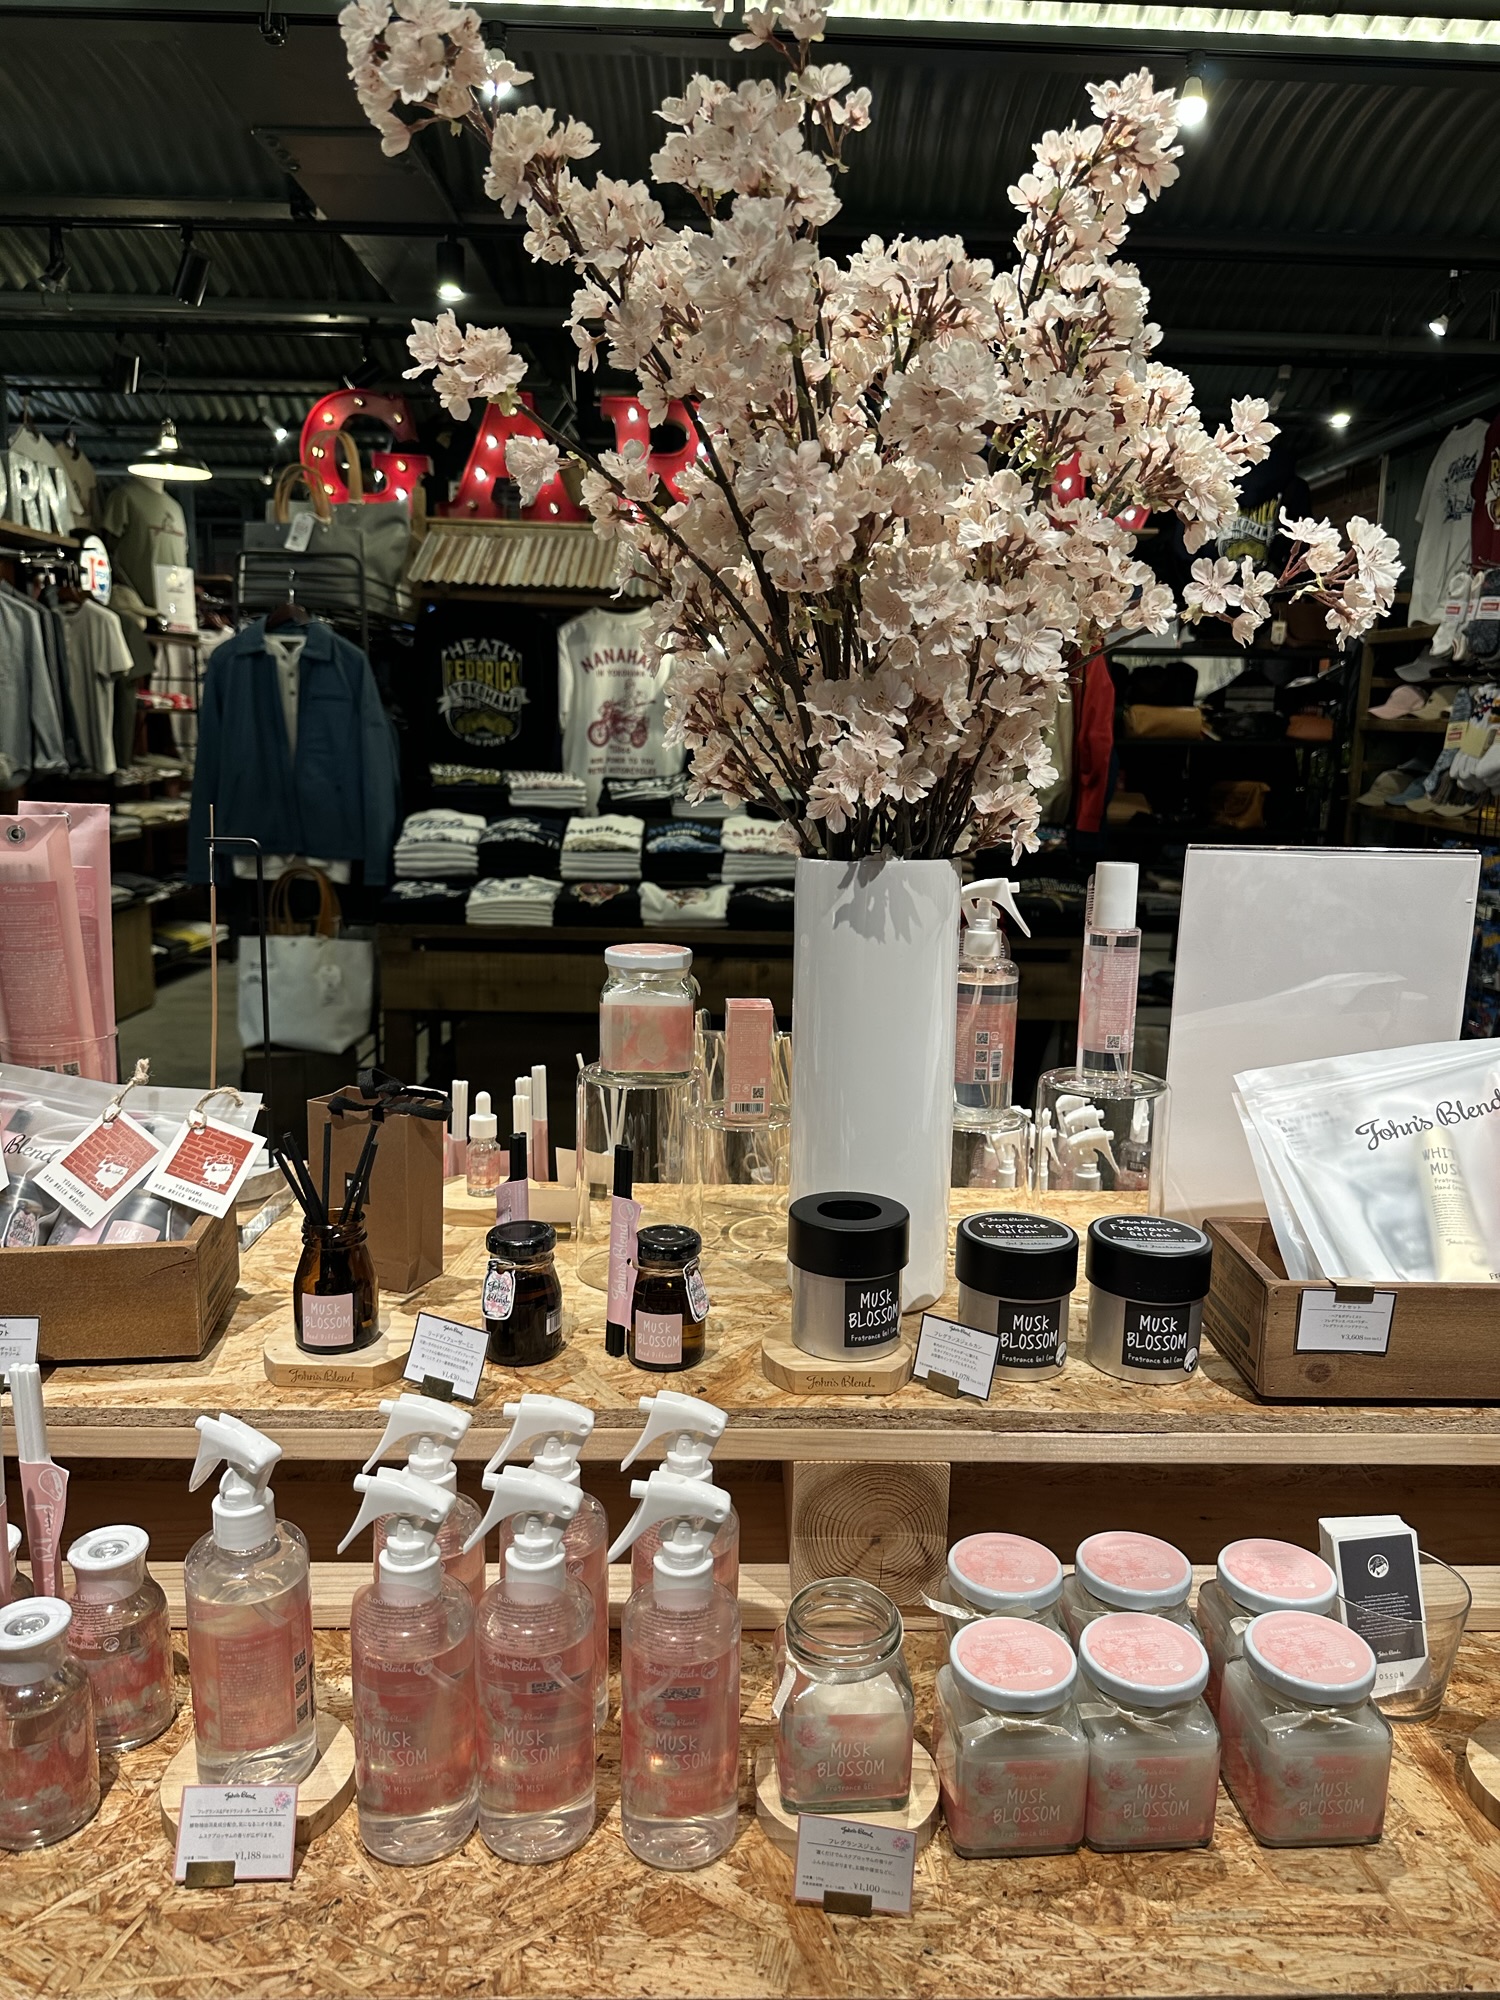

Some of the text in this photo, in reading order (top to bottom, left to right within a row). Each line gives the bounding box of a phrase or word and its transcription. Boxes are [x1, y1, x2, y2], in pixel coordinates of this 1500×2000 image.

[581, 648, 650, 674] NANAHA
[1354, 1088, 1500, 1151] John's Blend
[4, 1134, 61, 1163] Blend
[1422, 1147, 1458, 1161] WHIT
[1430, 1163, 1461, 1176] MUS
[115, 1225, 145, 1241] MUSK
[1109, 1223, 1181, 1233] Fragrance
[613, 1221, 629, 1258] Blend
[612, 1259, 628, 1301] John's
[860, 1288, 892, 1309] MUSK
[310, 1302, 341, 1315] MUSK
[848, 1300, 899, 1329] BLOSSOM
[305, 1315, 351, 1330] BLOSSOM
[643, 1319, 671, 1334] MUSK
[1013, 1314, 1050, 1332] MUSK
[1139, 1315, 1178, 1334] MUSK
[321, 1332, 348, 1341] Diffuser
[428, 1331, 474, 1349] リードディフューザーミニ
[637, 1333, 680, 1348] BLOSSOM
[850, 1332, 881, 1342] Fragrance
[882, 1328, 890, 1340] Gel
[934, 1331, 982, 1350] フレグランスジェルカン
[1000, 1330, 1058, 1350] BLOSSOM
[1126, 1331, 1187, 1351] BLOSSOM
[1001, 1353, 1055, 1364] Fragrance Gel Can
[1127, 1352, 1183, 1364] Fragrance Gel Can
[289, 1369, 355, 1383] John's Blend
[806, 1375, 873, 1390] John's Blend
[952, 1370, 970, 1382] ¥1,078
[497, 1593, 521, 1605] Room
[978, 1632, 1013, 1640] Fragrance
[1269, 1626, 1300, 1634] Fragrance
[382, 1661, 407, 1673] Blend
[511, 1660, 537, 1672] Blend
[372, 1727, 412, 1748] MUSK
[504, 1726, 545, 1746] MUSK
[656, 1732, 698, 1752] MUSK
[363, 1742, 428, 1767] BLOSSOM
[493, 1742, 560, 1766] BLOSSOM
[830, 1741, 871, 1758] MUSK
[817, 1758, 885, 1778] BLOSSOM
[241, 1790, 256, 1800] Blend
[394, 1786, 412, 1795] MIST
[526, 1784, 545, 1793] MIST
[825, 1783, 874, 1792] Fragrance GEL
[1136, 1782, 1176, 1800] MUSK
[1313, 1781, 1352, 1798] MUSK
[1006, 1787, 1047, 1804] MUSK
[993, 1805, 1061, 1824] BLOSSOM
[1123, 1800, 1189, 1819] BLOSSOM
[1299, 1798, 1365, 1816] BLOSSOM
[857, 1827, 874, 1839] Blend
[1000, 1831, 1037, 1839] Fragrance
[1130, 1825, 1166, 1833] Fragrance
[828, 1838, 882, 1851] フレグランスジェル
[235, 1851, 262, 1861] ¥1,188
[853, 1882, 881, 1893] ¥1,100
